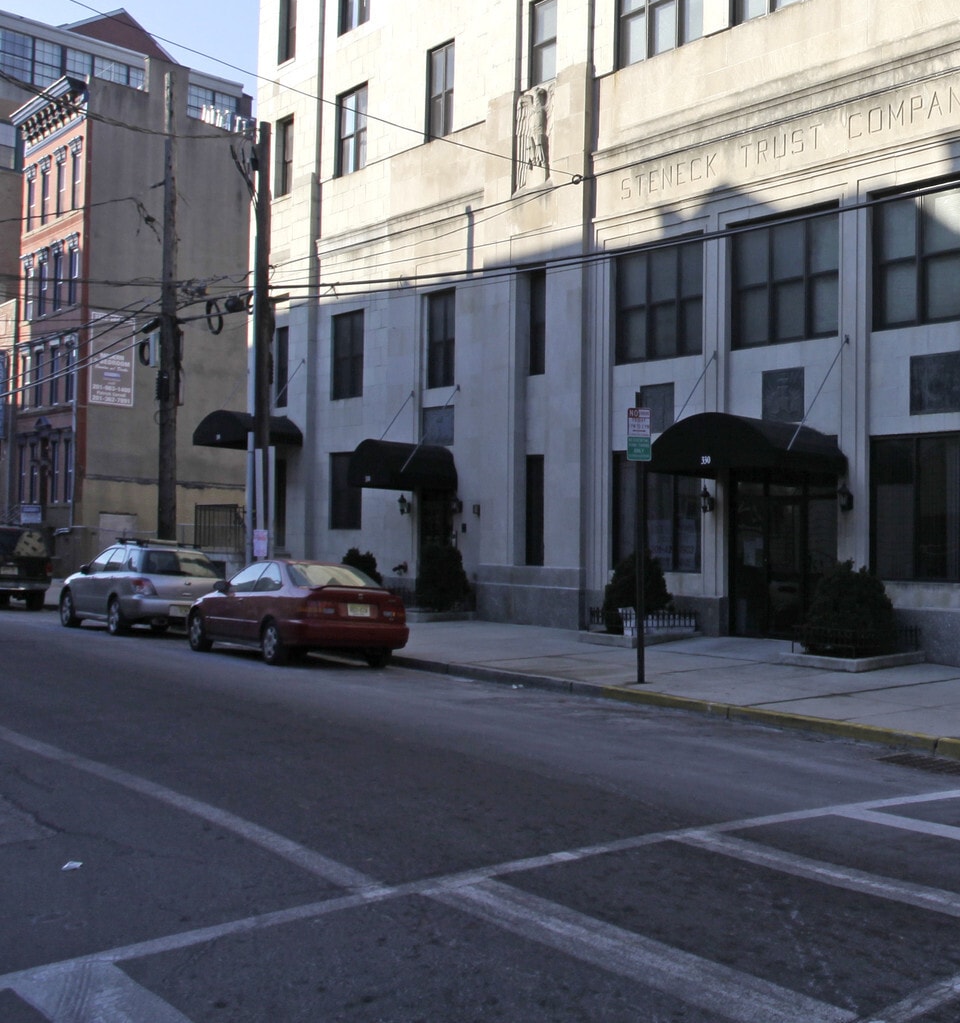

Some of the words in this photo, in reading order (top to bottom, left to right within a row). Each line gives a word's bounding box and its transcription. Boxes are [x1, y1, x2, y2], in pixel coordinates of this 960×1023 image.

[620, 153, 717, 200] STENECK
[740, 123, 824, 168] TRUST
[629, 409, 639, 417] NO
